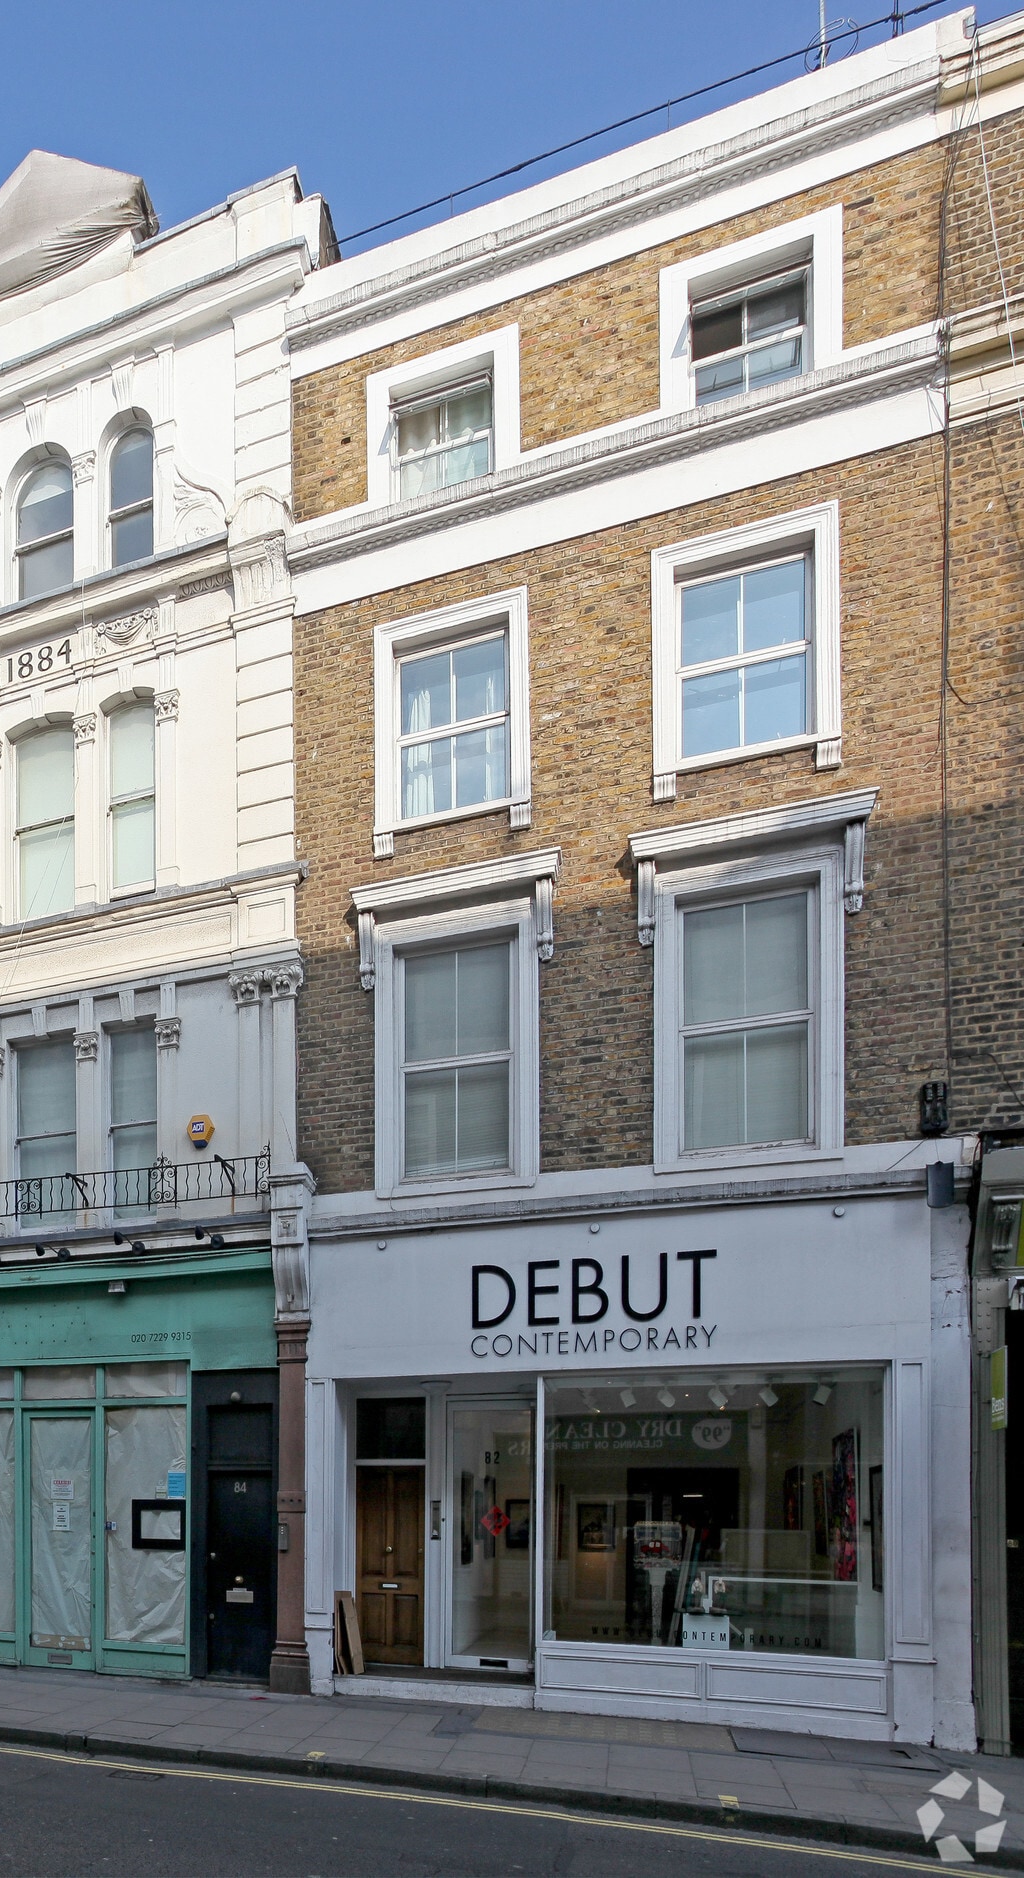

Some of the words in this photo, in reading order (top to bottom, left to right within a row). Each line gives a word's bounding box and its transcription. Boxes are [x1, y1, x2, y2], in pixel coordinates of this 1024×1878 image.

[7, 639, 71, 683] 1884
[192, 1122, 204, 1131] ADT
[471, 1249, 718, 1330] DEBUT
[131, 1334, 146, 1343] 020
[149, 1333, 169, 1342] 7229
[171, 1332, 192, 1341] 9315
[470, 1324, 718, 1358] CONTEMPORARY
[484, 1451, 500, 1464] 82
[234, 1481, 247, 1493] 84
